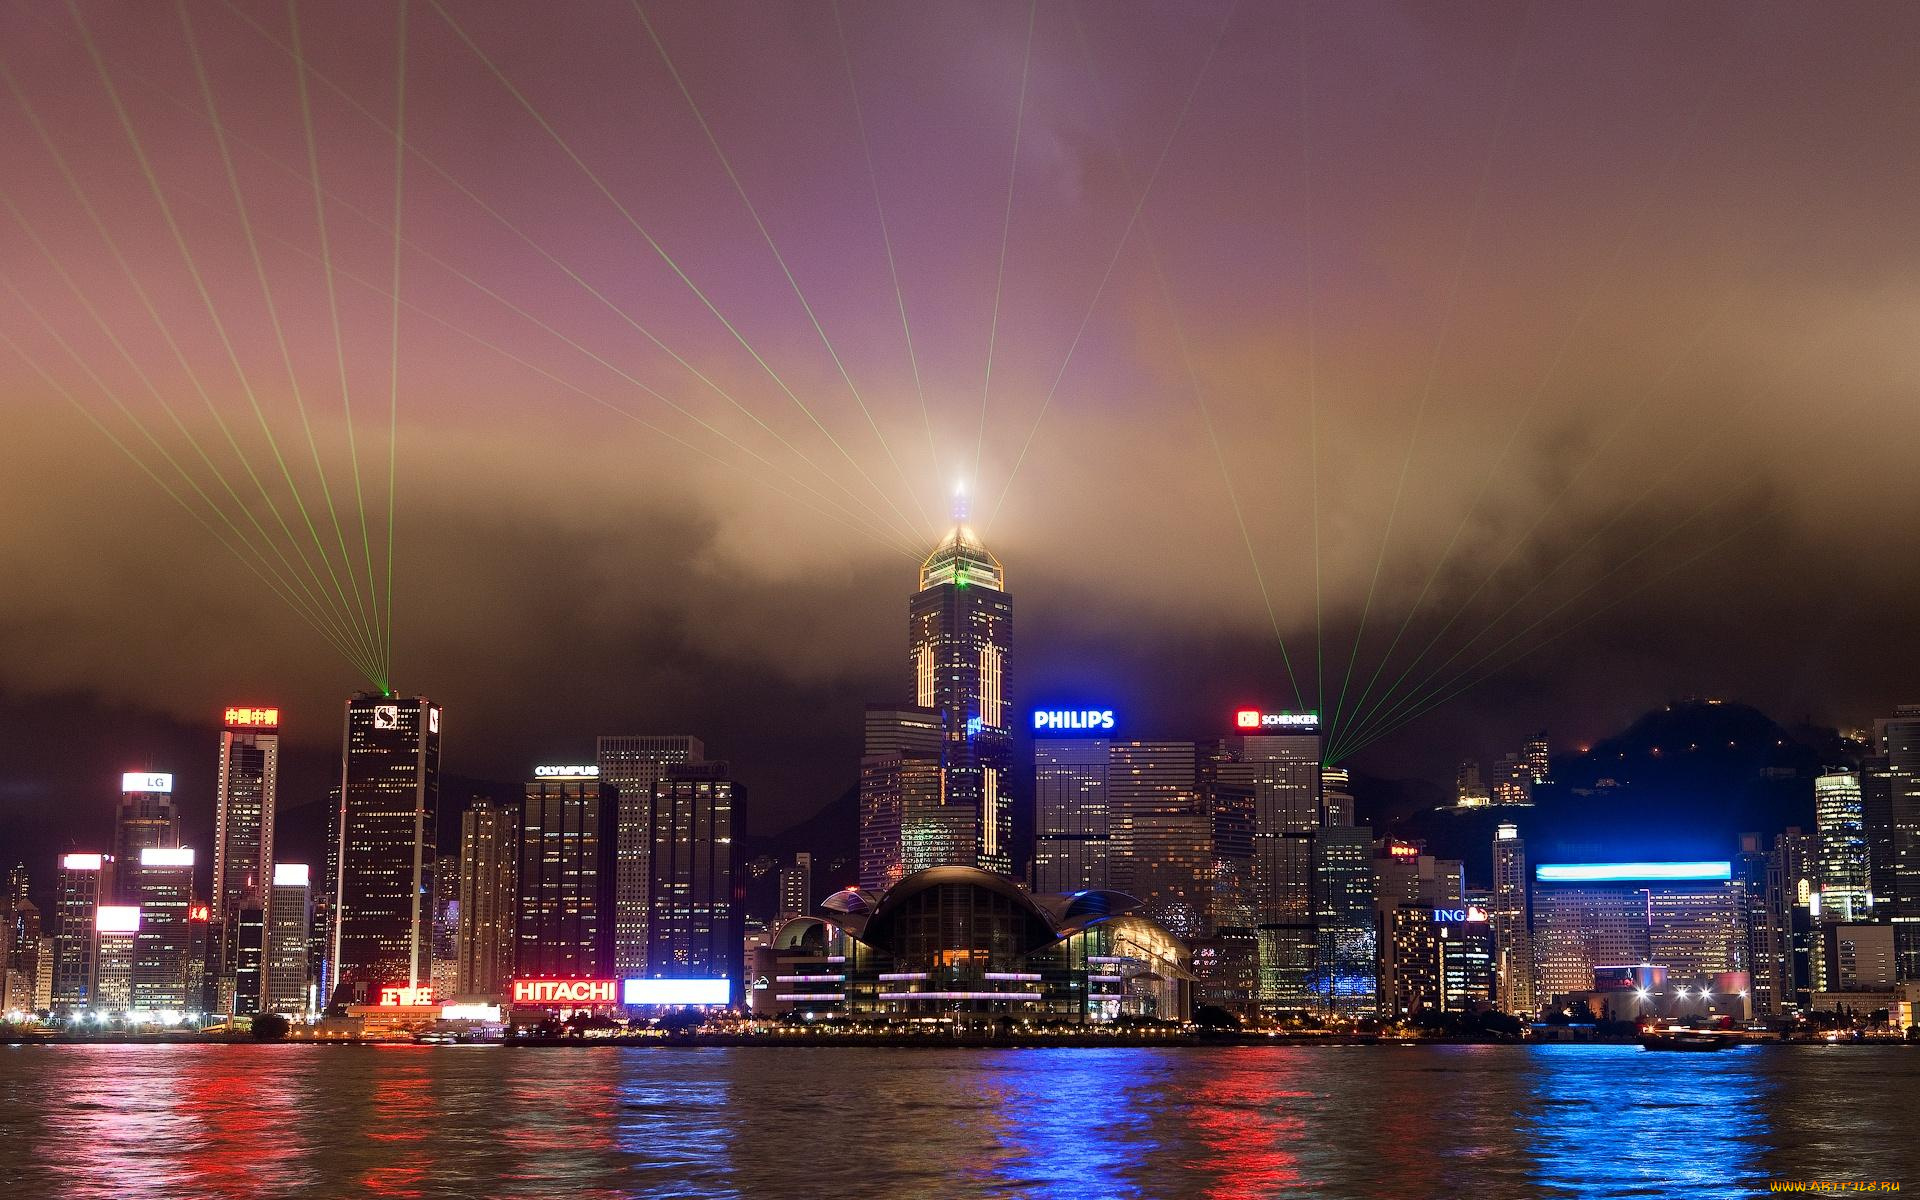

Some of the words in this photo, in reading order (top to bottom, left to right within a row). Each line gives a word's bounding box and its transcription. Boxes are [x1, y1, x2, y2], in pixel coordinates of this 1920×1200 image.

[1035, 711, 1114, 728] PHILIPS
[1262, 715, 1318, 724] SCHENKER
[535, 766, 599, 775] OLYMPUS
[147, 777, 164, 787] LG
[1434, 909, 1465, 922] ING
[516, 982, 616, 1001] HITACHI
